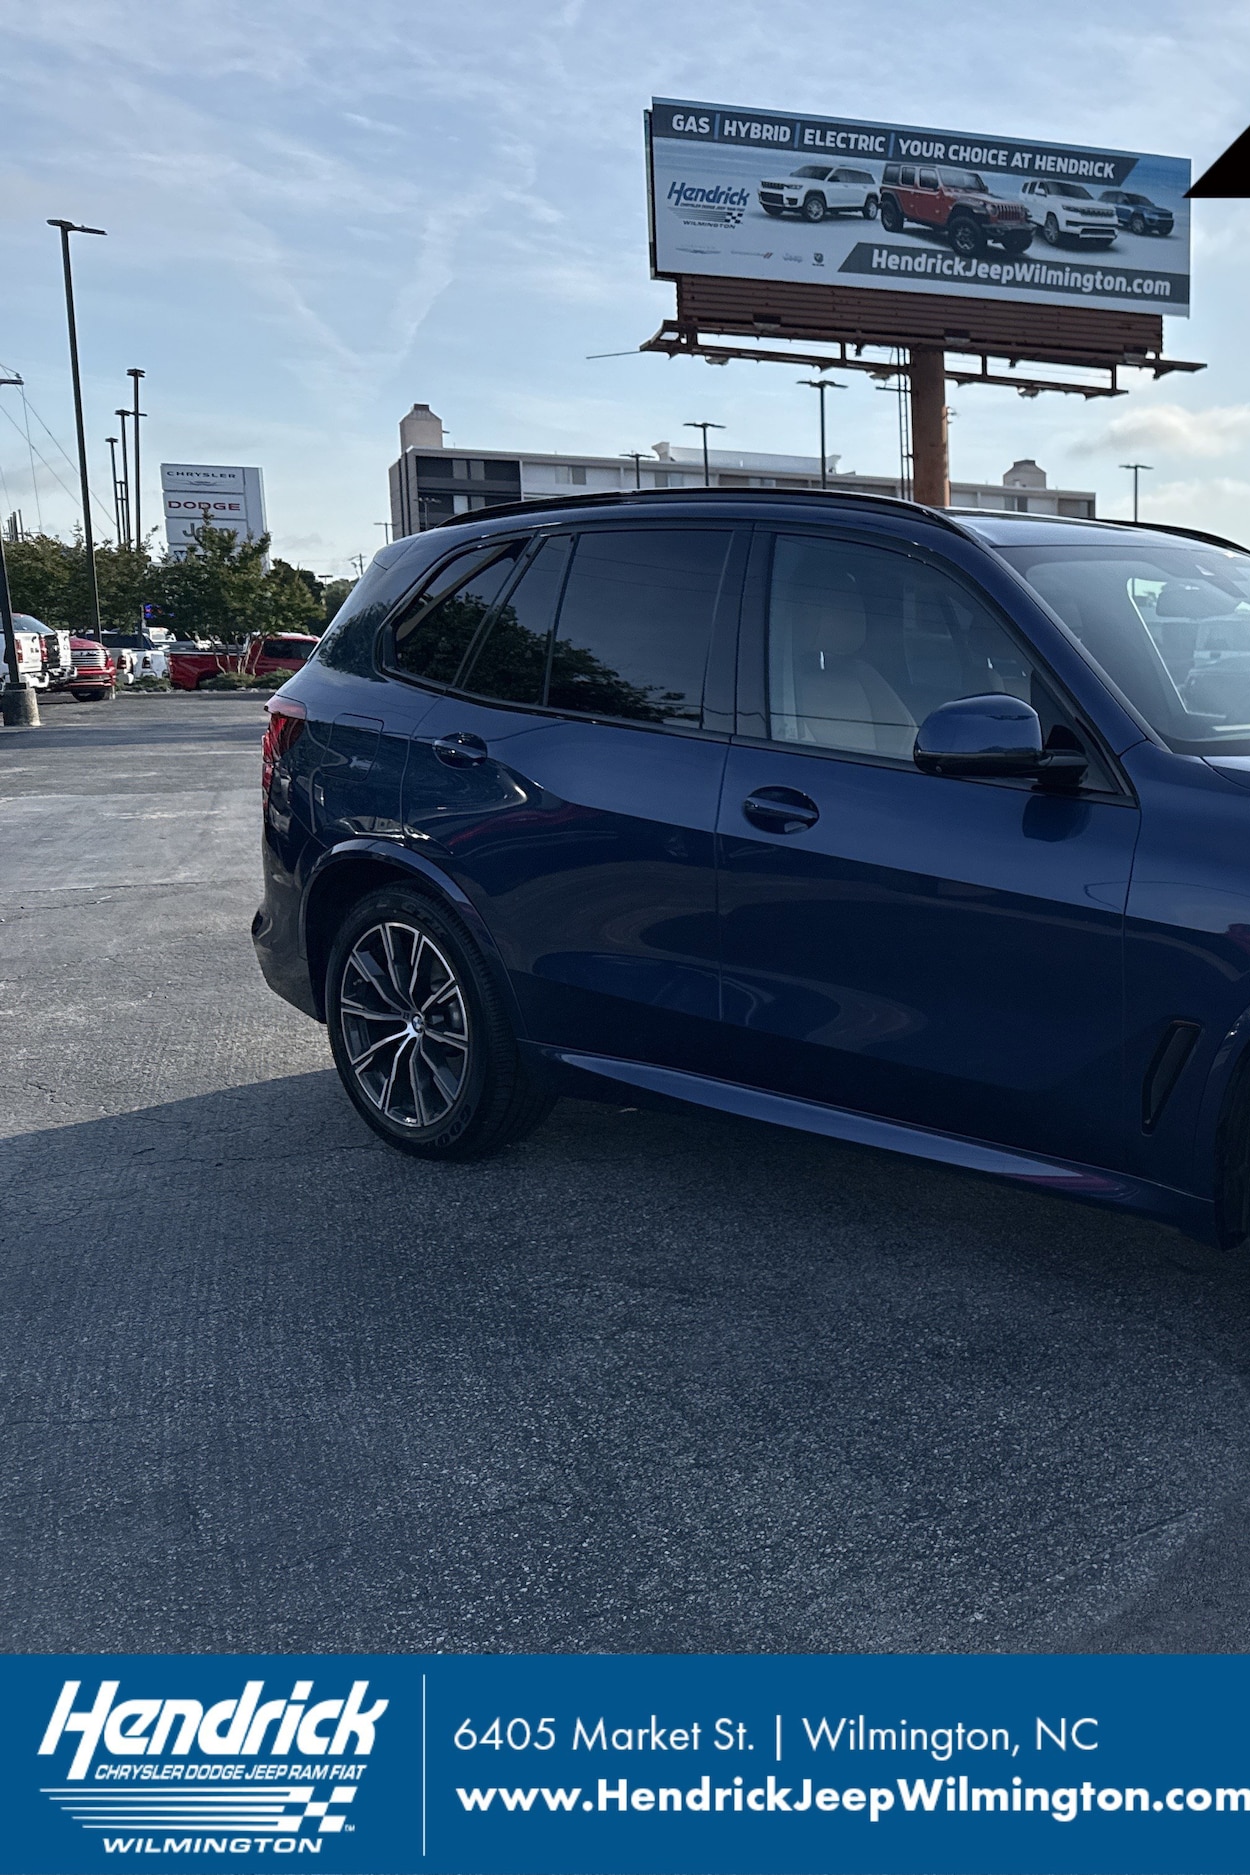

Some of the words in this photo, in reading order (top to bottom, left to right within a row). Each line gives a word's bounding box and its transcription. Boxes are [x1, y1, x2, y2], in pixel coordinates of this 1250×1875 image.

[672, 114, 710, 133] GAS
[723, 119, 791, 143] HYBRID
[803, 129, 886, 152] ELECTRIC
[899, 138, 944, 159] YOUR
[949, 144, 1007, 167] CHOICE
[1011, 152, 1032, 169] AT
[1035, 154, 1116, 180] HENDRICK
[667, 181, 750, 206] Hendrick
[871, 248, 1172, 297] HendrickJeepWilmington.com
[166, 471, 236, 479] CHRYSLER
[168, 501, 241, 511] DODGE
